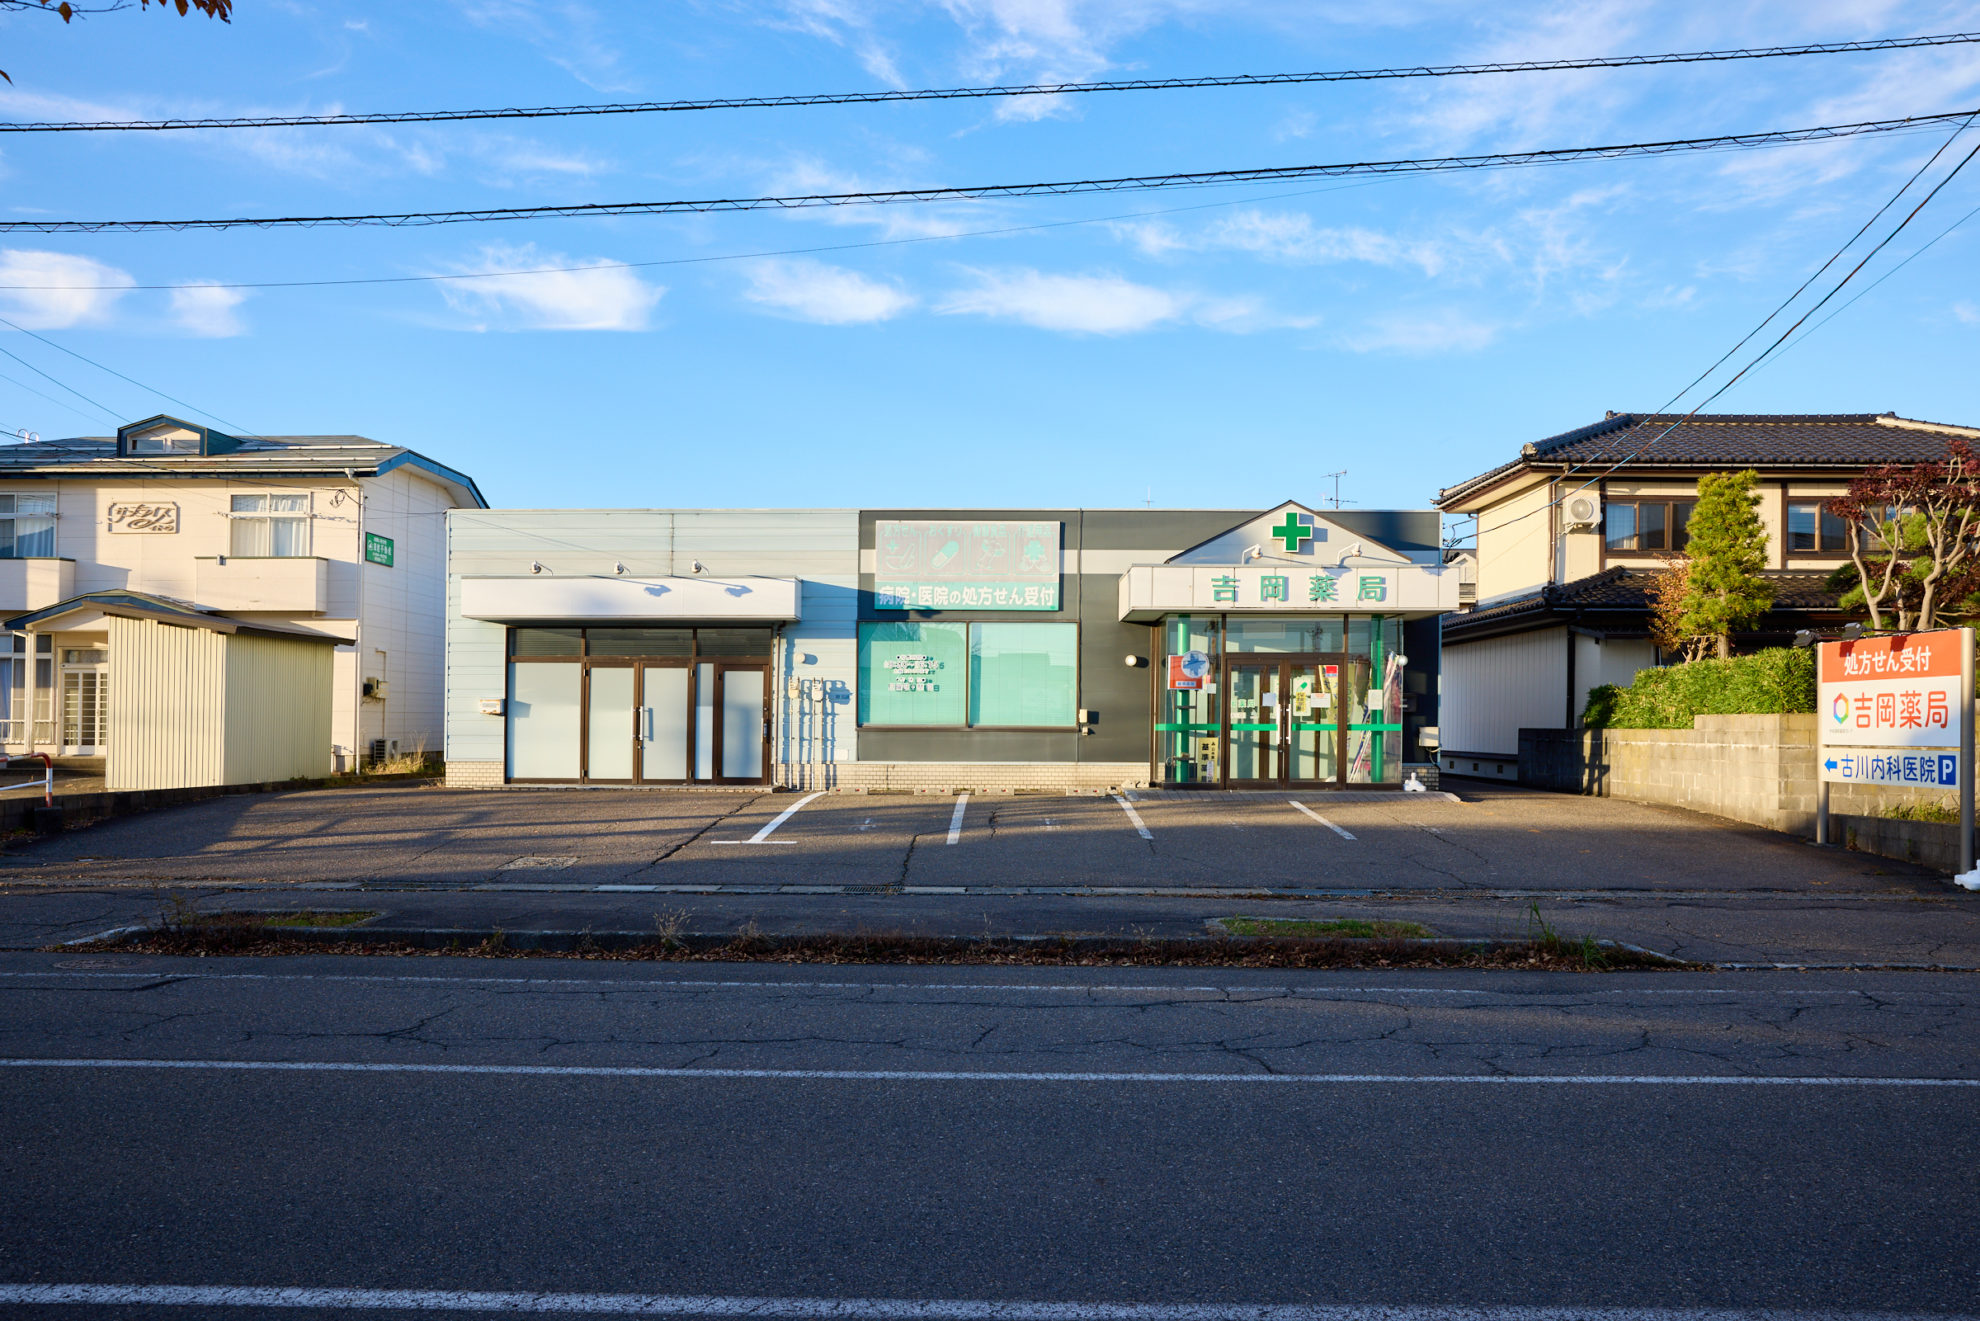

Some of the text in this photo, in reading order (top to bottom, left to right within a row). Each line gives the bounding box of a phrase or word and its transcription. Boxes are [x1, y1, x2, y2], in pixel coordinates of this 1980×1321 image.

[879, 586, 1055, 606] 病院・医院の処方せん受付
[1211, 575, 1386, 602] 吉岡薬局
[1844, 646, 1931, 675] 処方せん受付
[1854, 690, 1949, 729] 吉岡薬局
[1841, 753, 1954, 783] 古川内科医院 P
